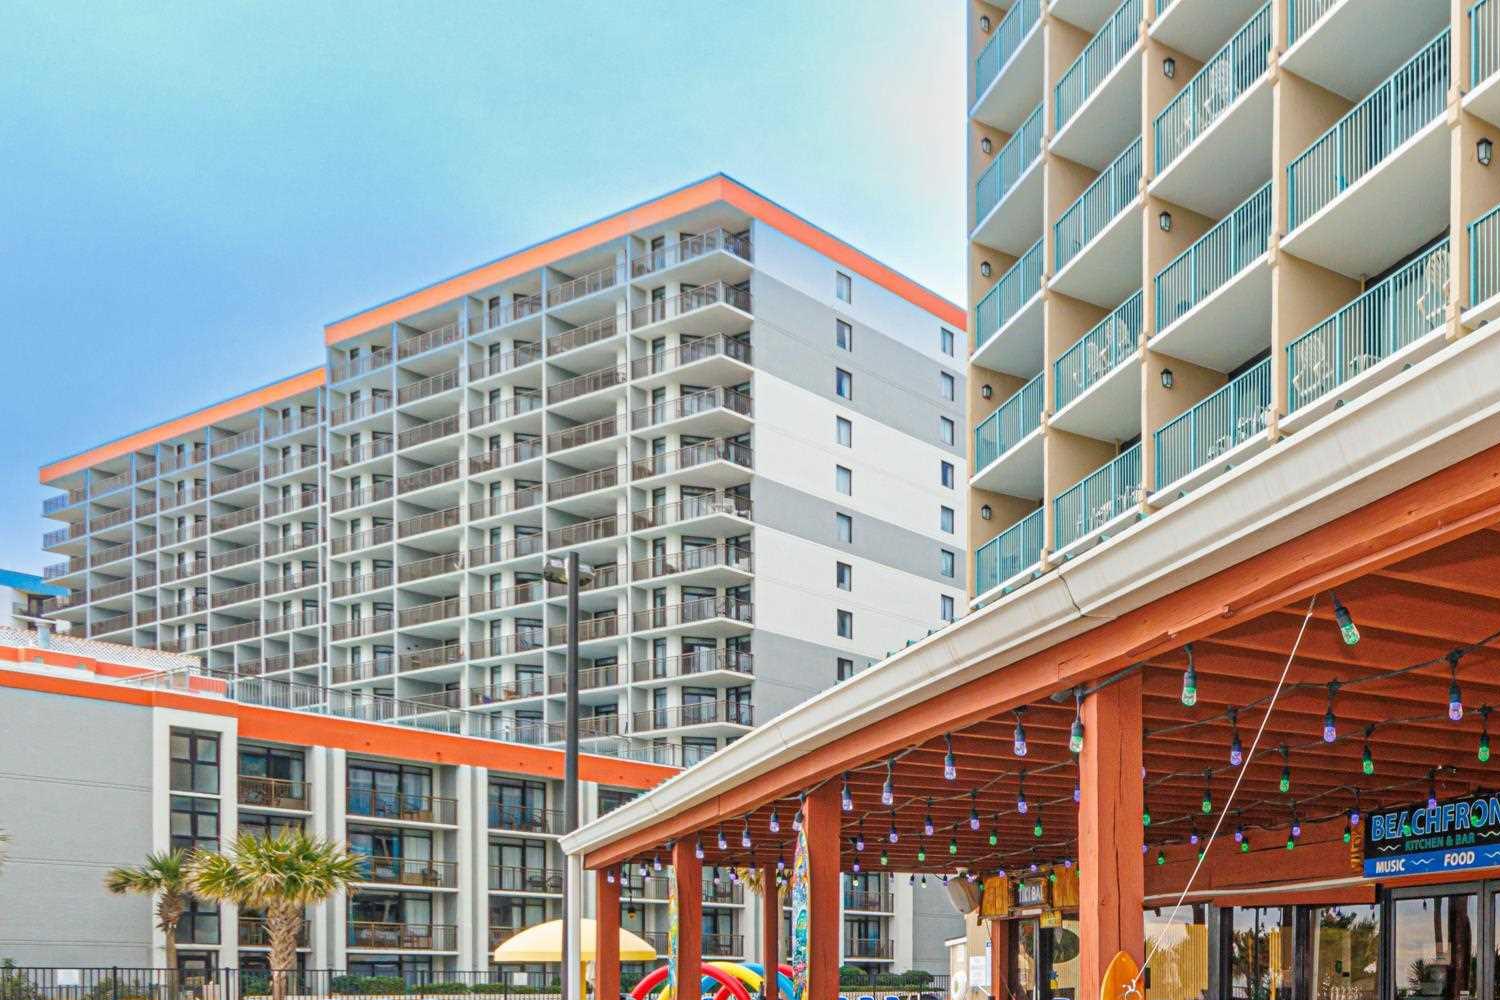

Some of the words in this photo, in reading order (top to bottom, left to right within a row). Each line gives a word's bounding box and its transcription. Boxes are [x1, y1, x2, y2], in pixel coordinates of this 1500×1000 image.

[1405, 837, 1443, 851] KITCHEN
[1455, 832, 1476, 845] BAR
[1375, 859, 1406, 873] MUSIC
[1444, 851, 1475, 867] FOOD
